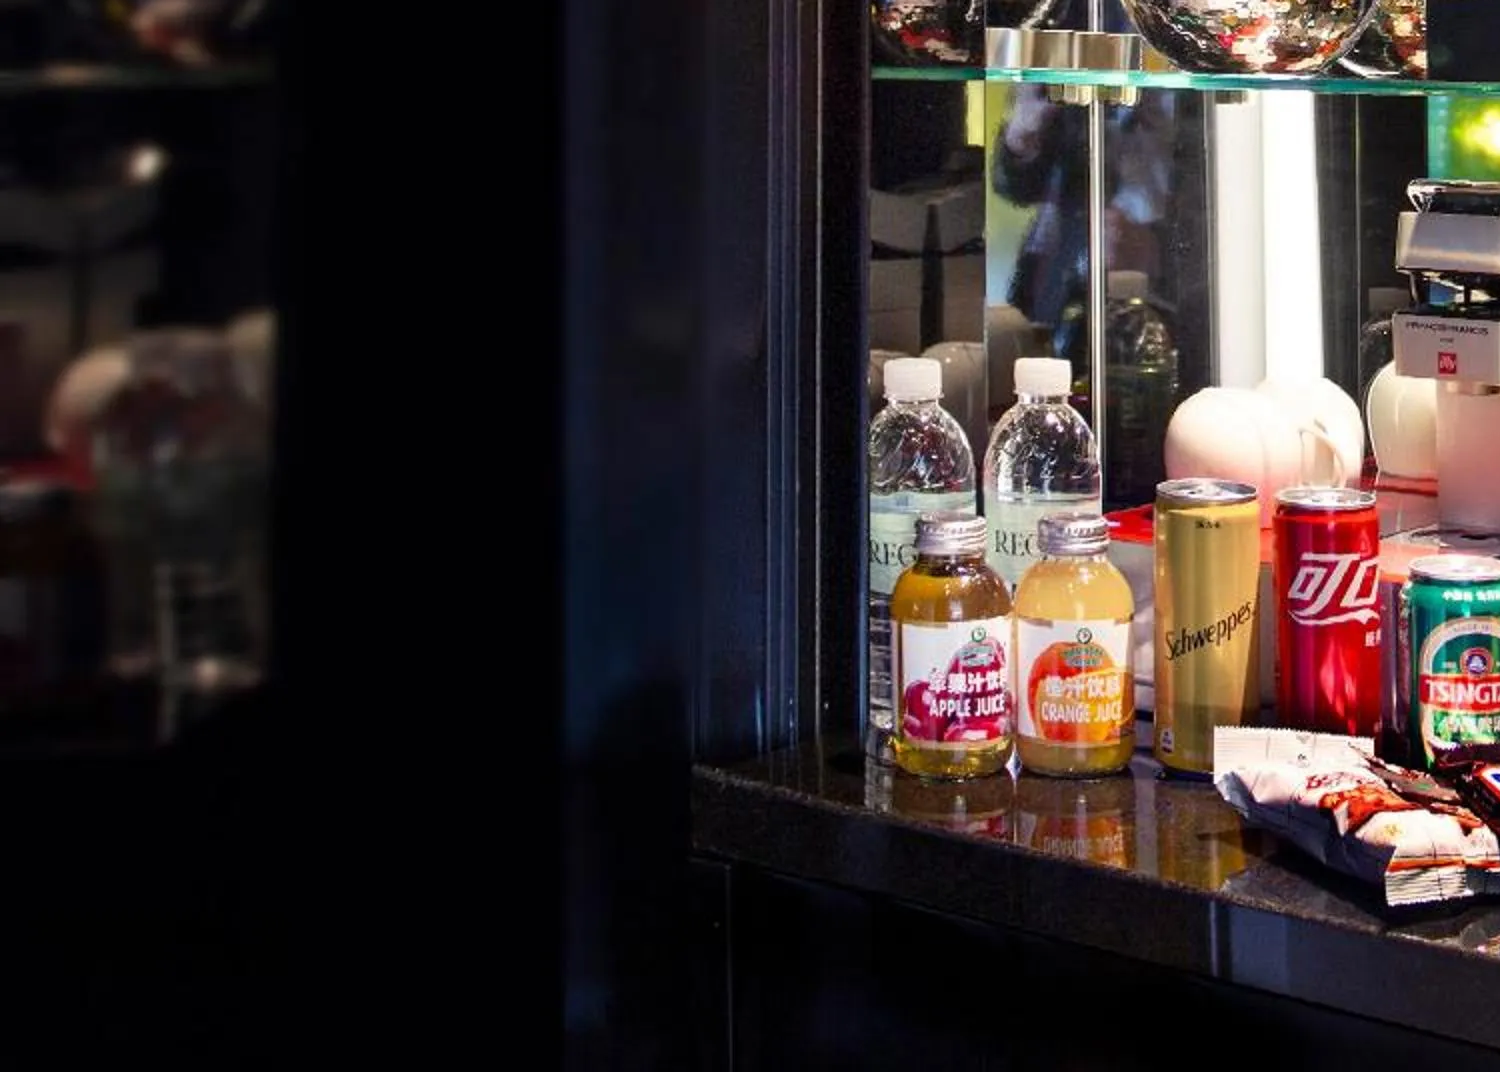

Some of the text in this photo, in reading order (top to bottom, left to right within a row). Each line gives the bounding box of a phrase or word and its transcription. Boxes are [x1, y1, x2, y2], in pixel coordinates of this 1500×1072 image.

[1165, 600, 1255, 662] Schweppes
[928, 694, 1006, 718] APPLE JUICE
[1041, 701, 1091, 724] ORANGE
